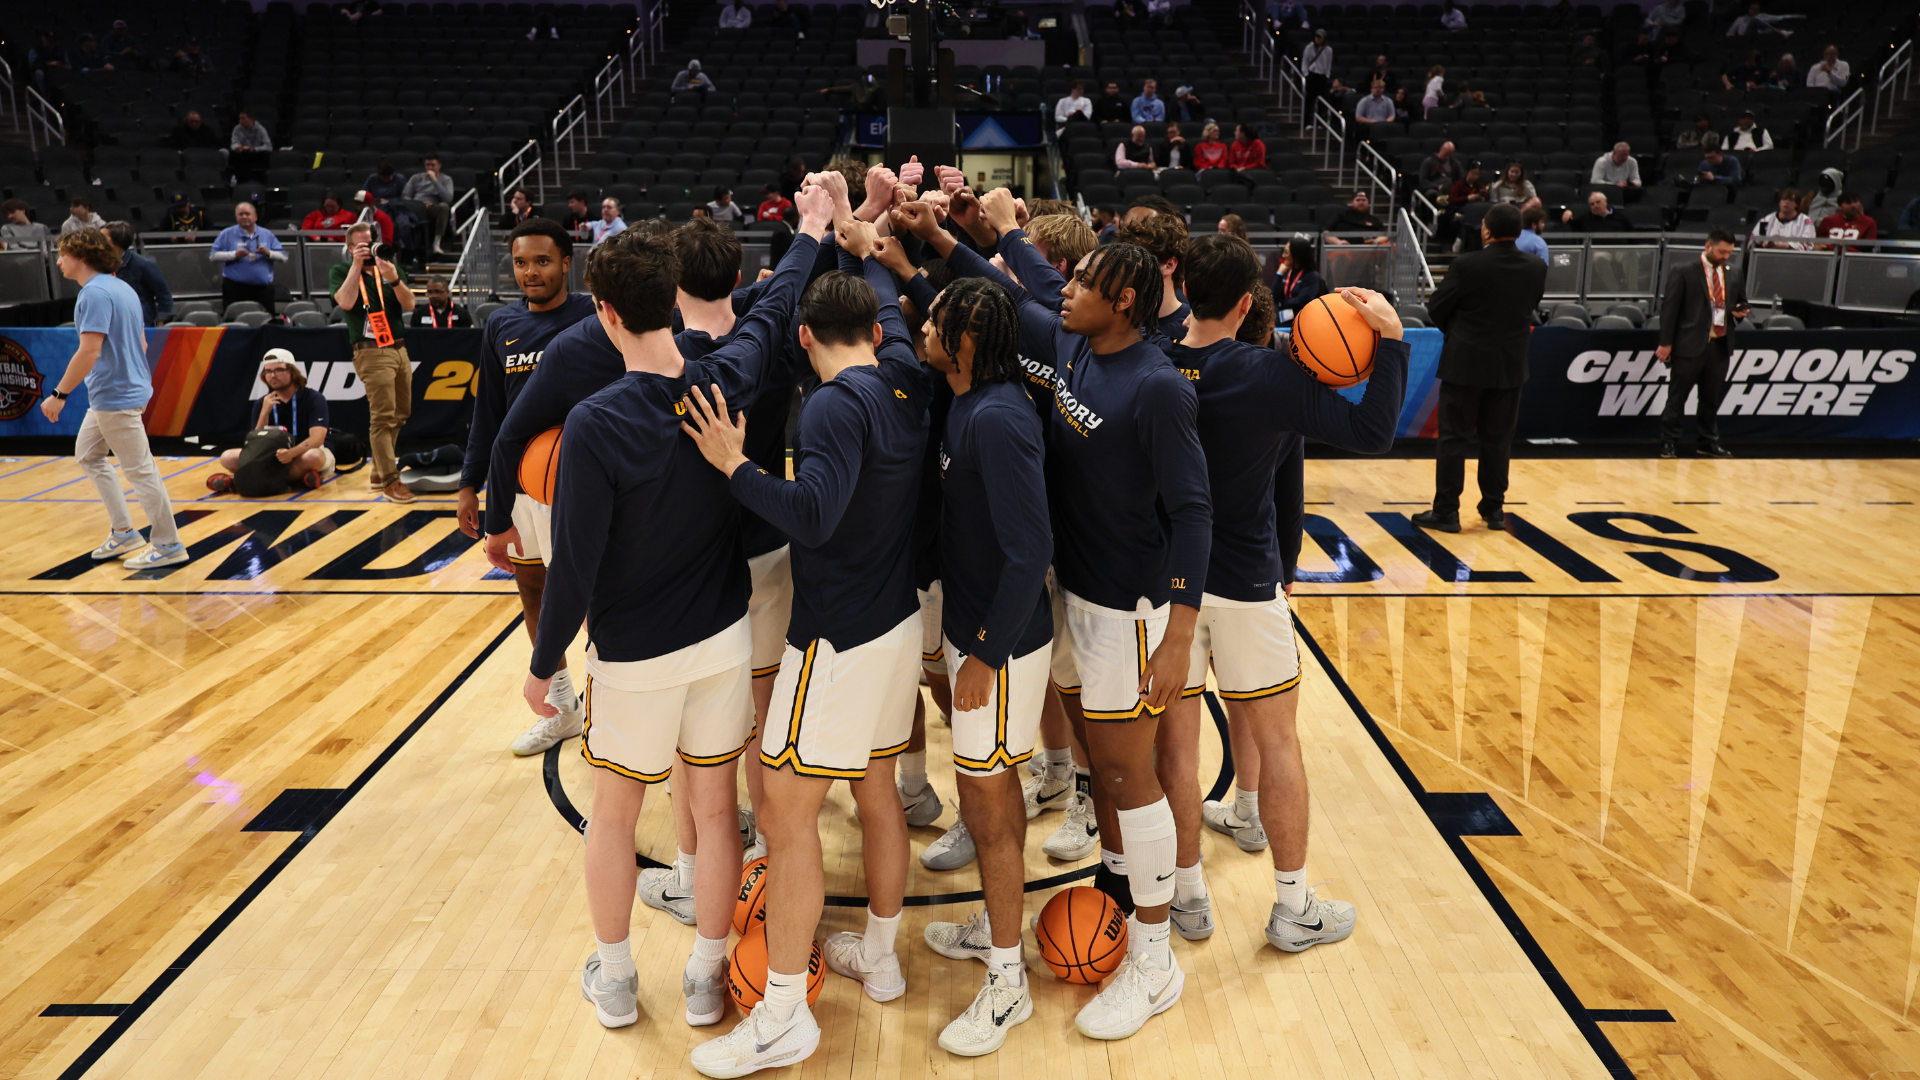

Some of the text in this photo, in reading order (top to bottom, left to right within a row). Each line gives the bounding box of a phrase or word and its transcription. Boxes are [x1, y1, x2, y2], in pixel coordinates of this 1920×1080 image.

[249, 361, 421, 400] IND
[1017, 353, 1058, 382] MOR
[1566, 349, 1917, 383] CHAPIONS
[1716, 384, 1876, 416] HERE
[737, 862, 768, 903] NCAA
